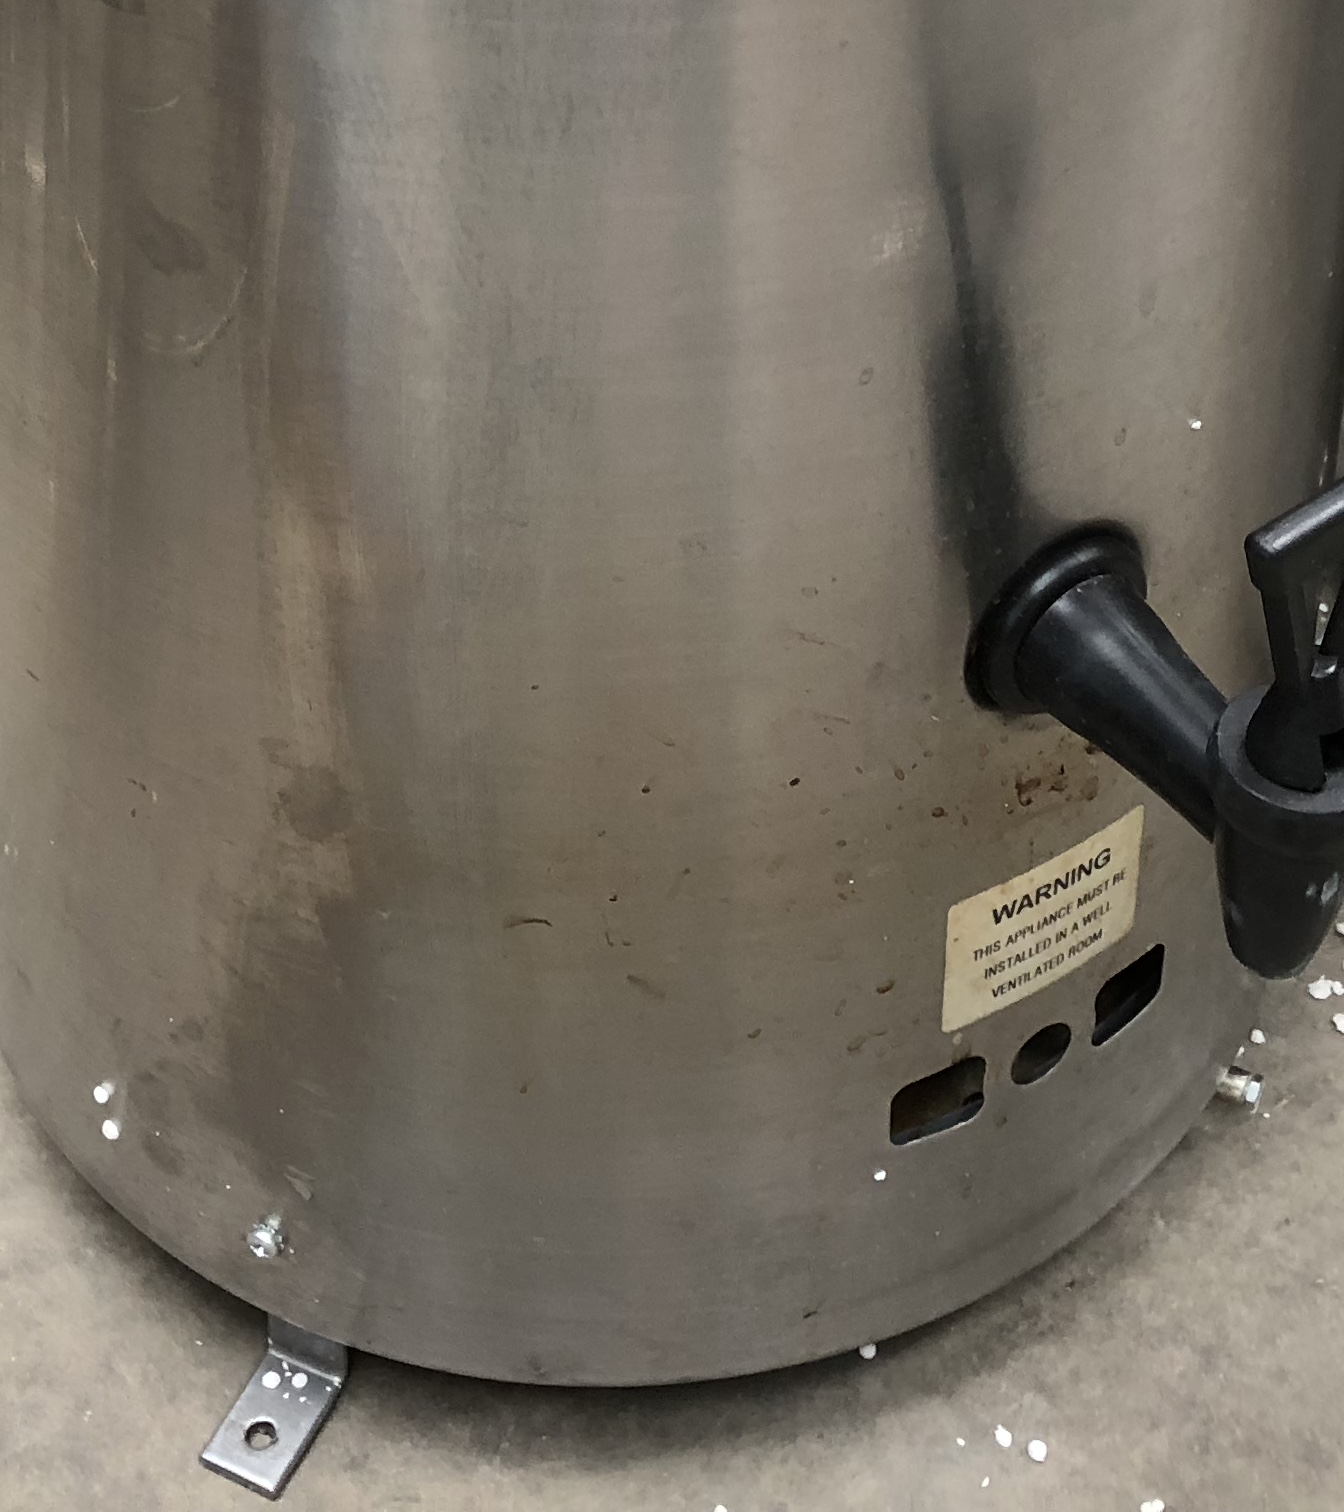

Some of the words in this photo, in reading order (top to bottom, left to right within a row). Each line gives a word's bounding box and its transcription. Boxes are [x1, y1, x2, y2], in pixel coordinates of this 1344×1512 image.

[973, 940, 1001, 962] THIS
[1005, 901, 1073, 947] APPLIANCE
[1077, 879, 1109, 909] MUST
[992, 848, 1111, 925] WARNING
[984, 937, 1052, 979] INSTALLED
[1055, 928, 1068, 944] IN
[1071, 922, 1079, 934] A
[1082, 901, 1113, 927] WELL
[992, 952, 1065, 998] VENTILATED
[1068, 928, 1103, 959] ROOM
